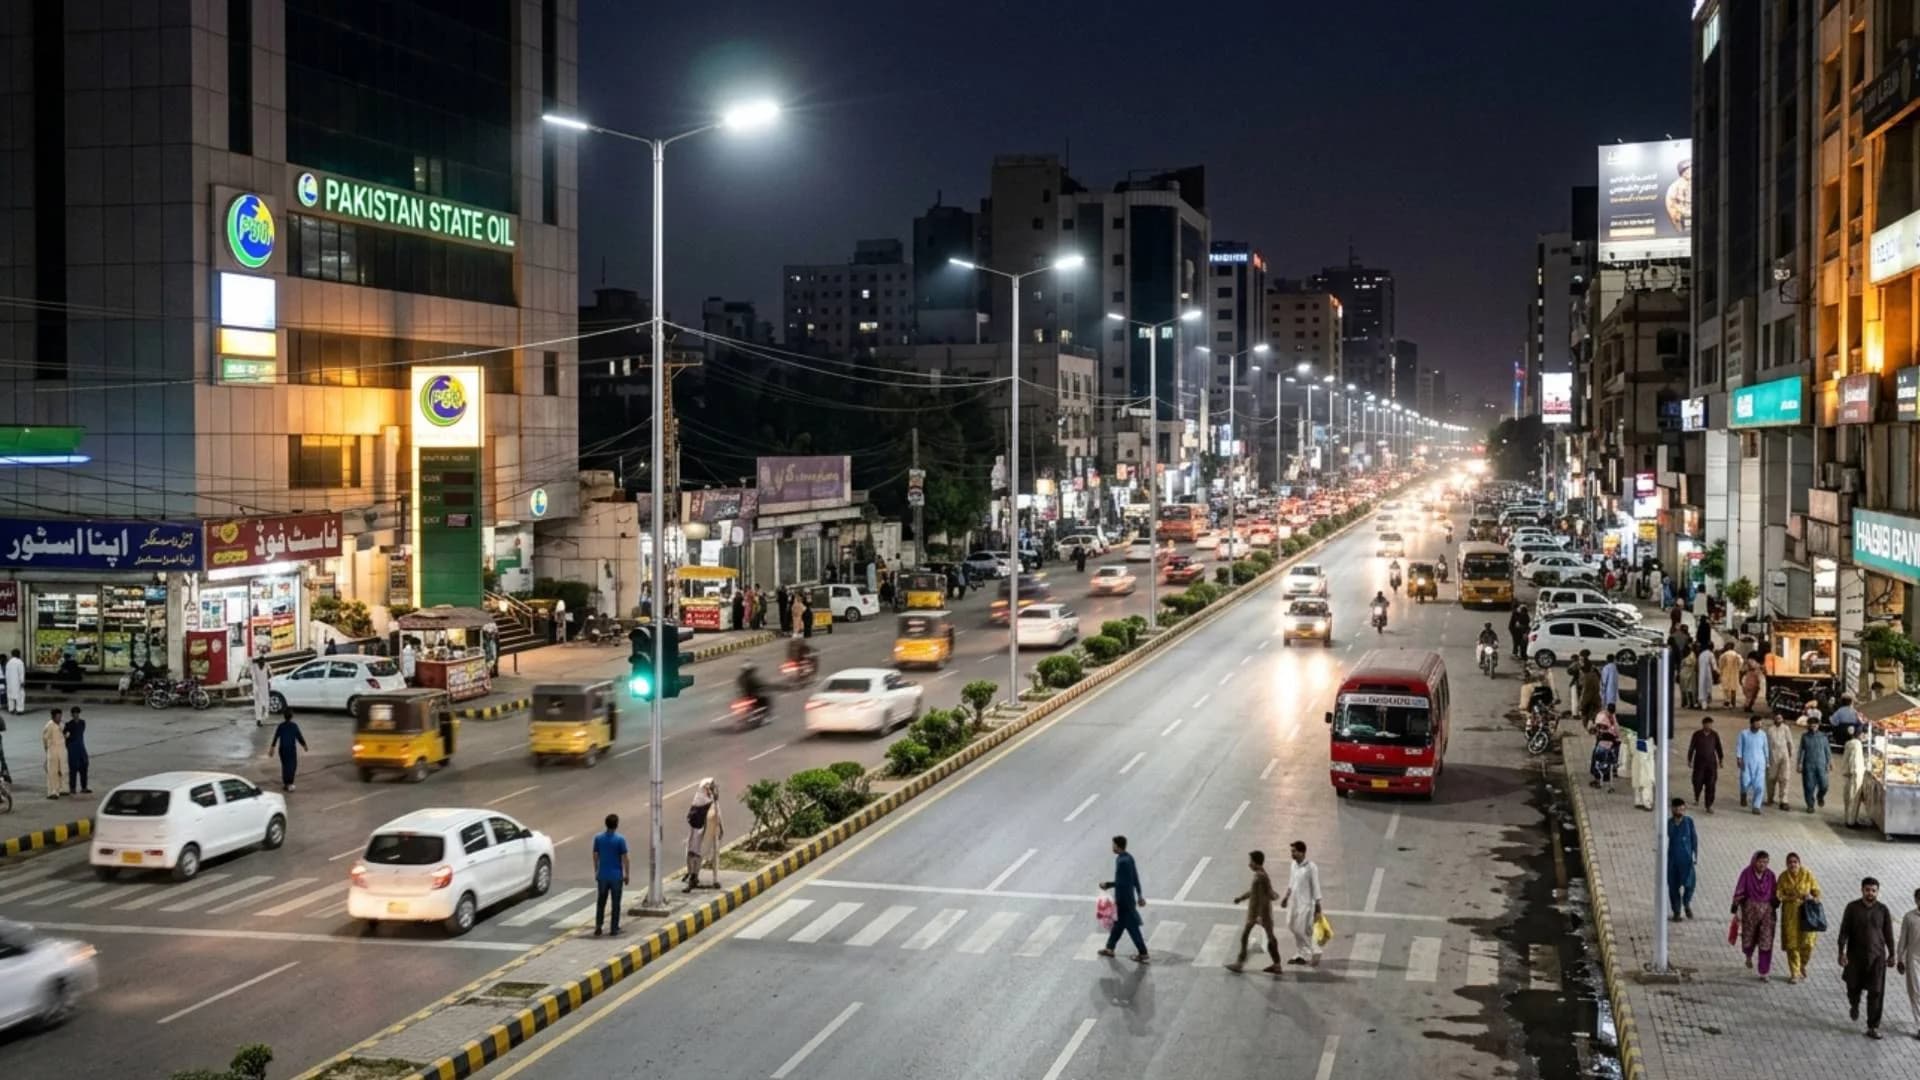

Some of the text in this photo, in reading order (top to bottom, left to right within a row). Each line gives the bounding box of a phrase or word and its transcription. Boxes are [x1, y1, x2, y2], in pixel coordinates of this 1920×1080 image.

[326, 179, 515, 247] PAKISTAN STATE OIL
[6, 526, 83, 561] اسٹور
[86, 527, 129, 568] اپنا
[1856, 520, 1891, 559] HABIB
